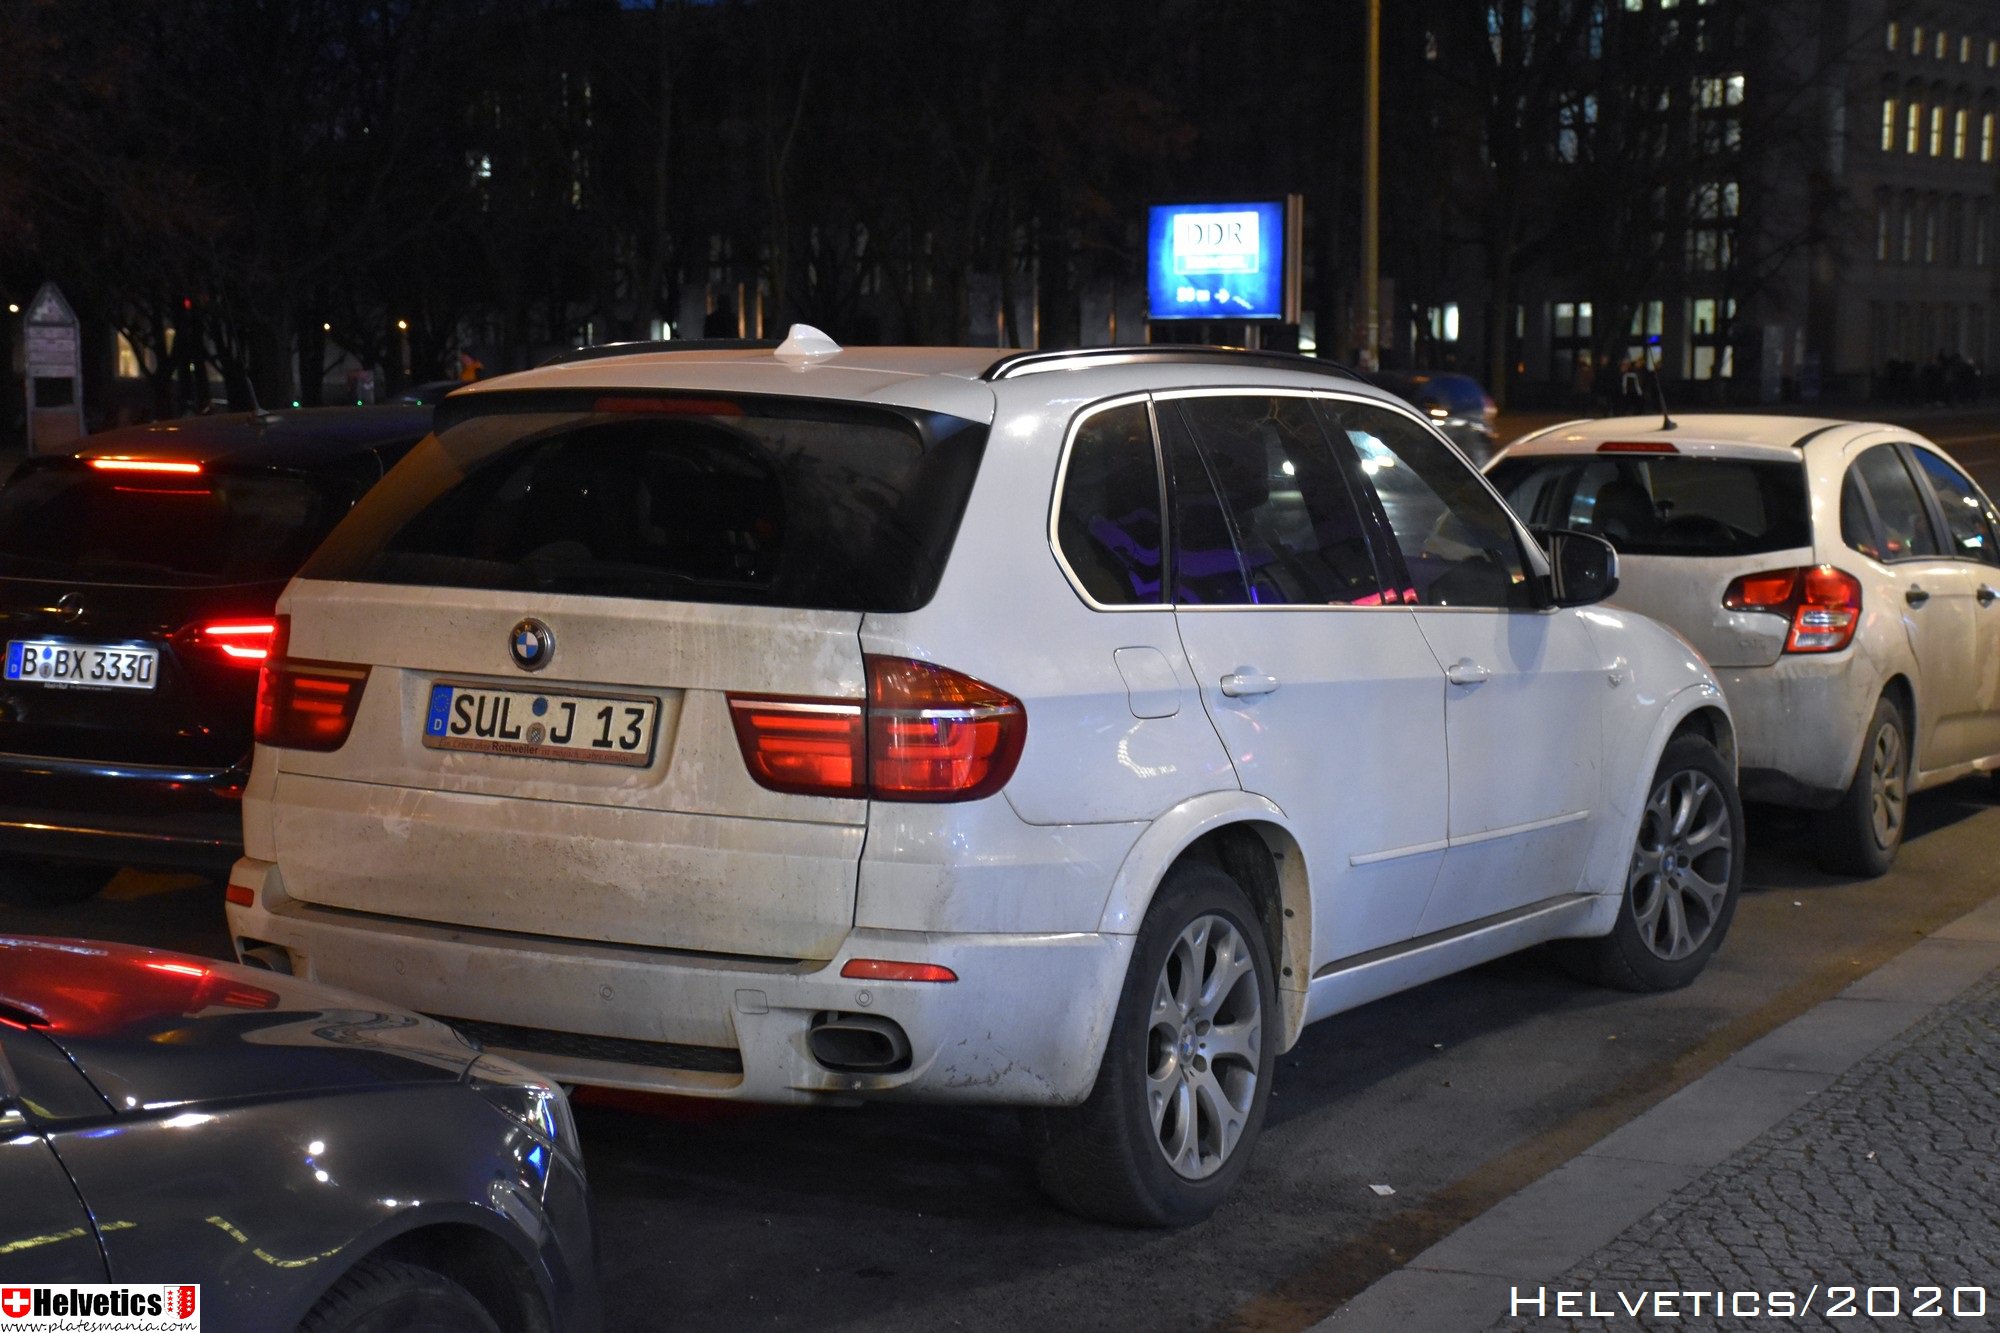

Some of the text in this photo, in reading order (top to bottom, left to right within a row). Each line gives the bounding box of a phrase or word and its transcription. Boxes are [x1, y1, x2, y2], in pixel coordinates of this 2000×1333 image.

[1187, 222, 1242, 245] DDR
[22, 647, 153, 683] B BX 3330
[433, 718, 442, 731] D
[450, 693, 645, 750] SUL J 13
[492, 741, 538, 755] Rottweiler
